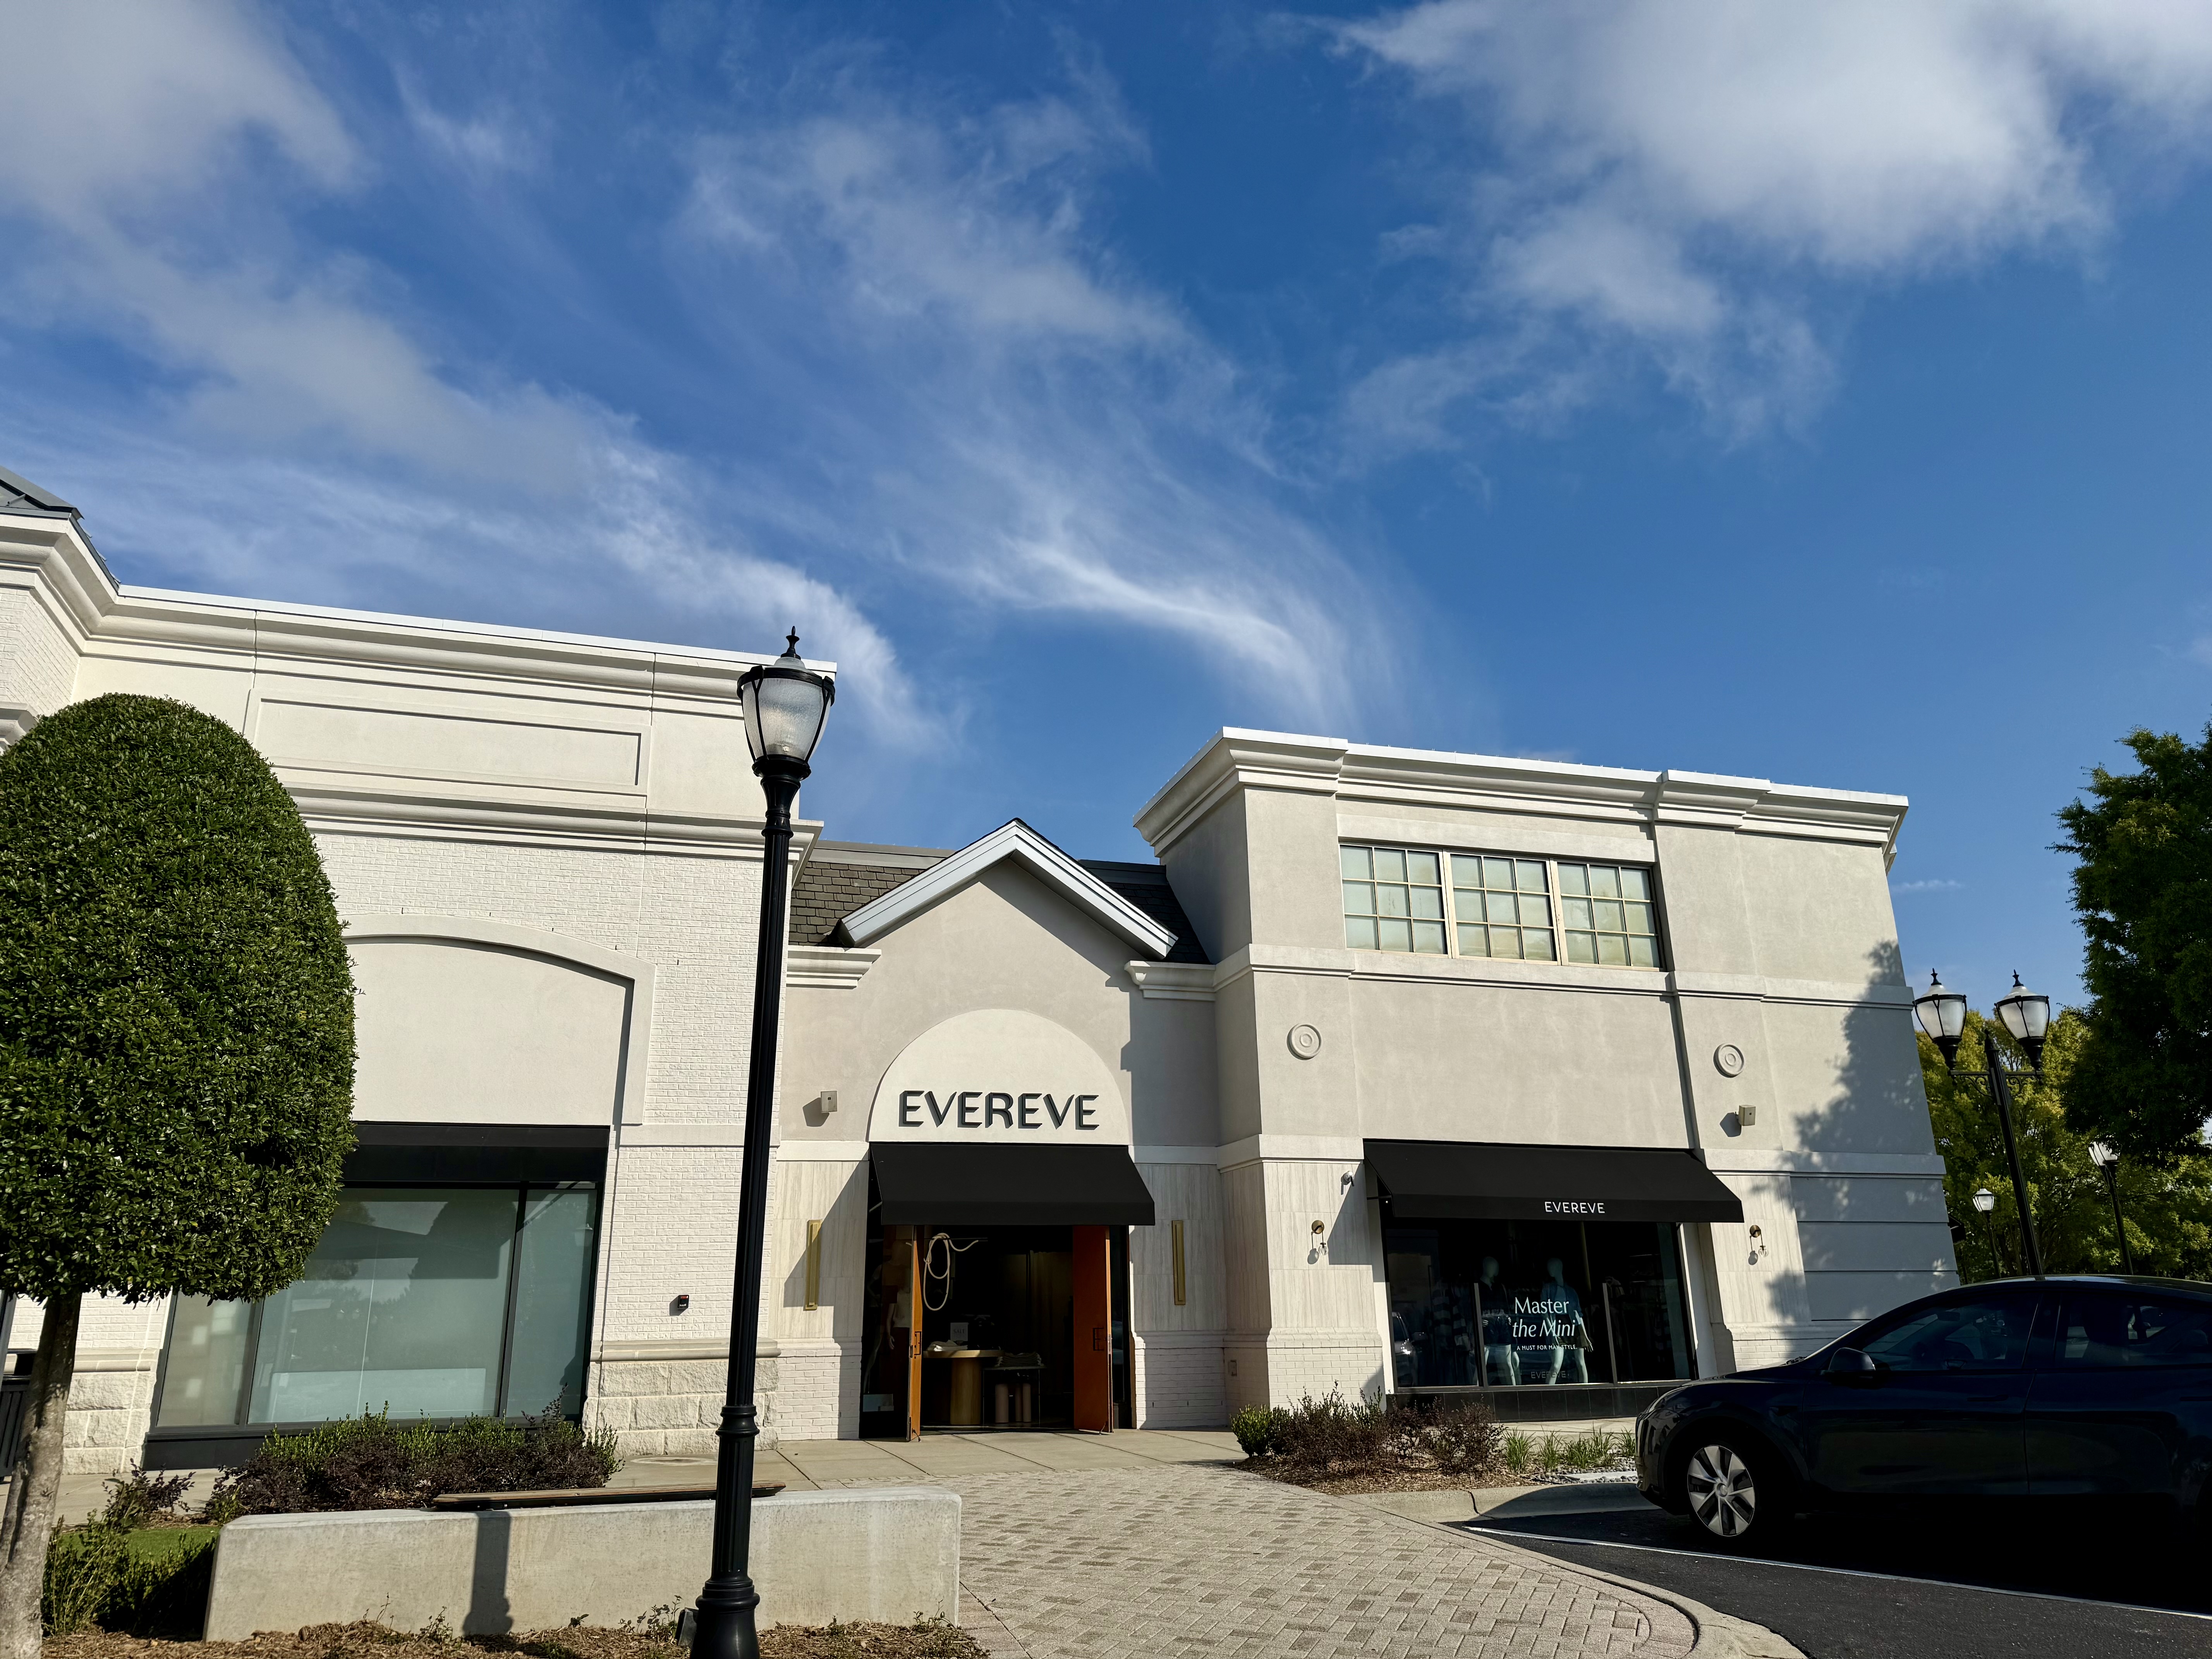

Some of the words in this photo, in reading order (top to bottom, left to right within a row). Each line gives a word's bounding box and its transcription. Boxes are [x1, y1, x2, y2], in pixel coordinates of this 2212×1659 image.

[898, 1090, 1099, 1130] EVEREVE
[1545, 1202, 1605, 1213] EVEREVE
[1515, 1297, 1569, 1314] Master
[1512, 1319, 1537, 1337] the
[1539, 1319, 1576, 1337] Mini
